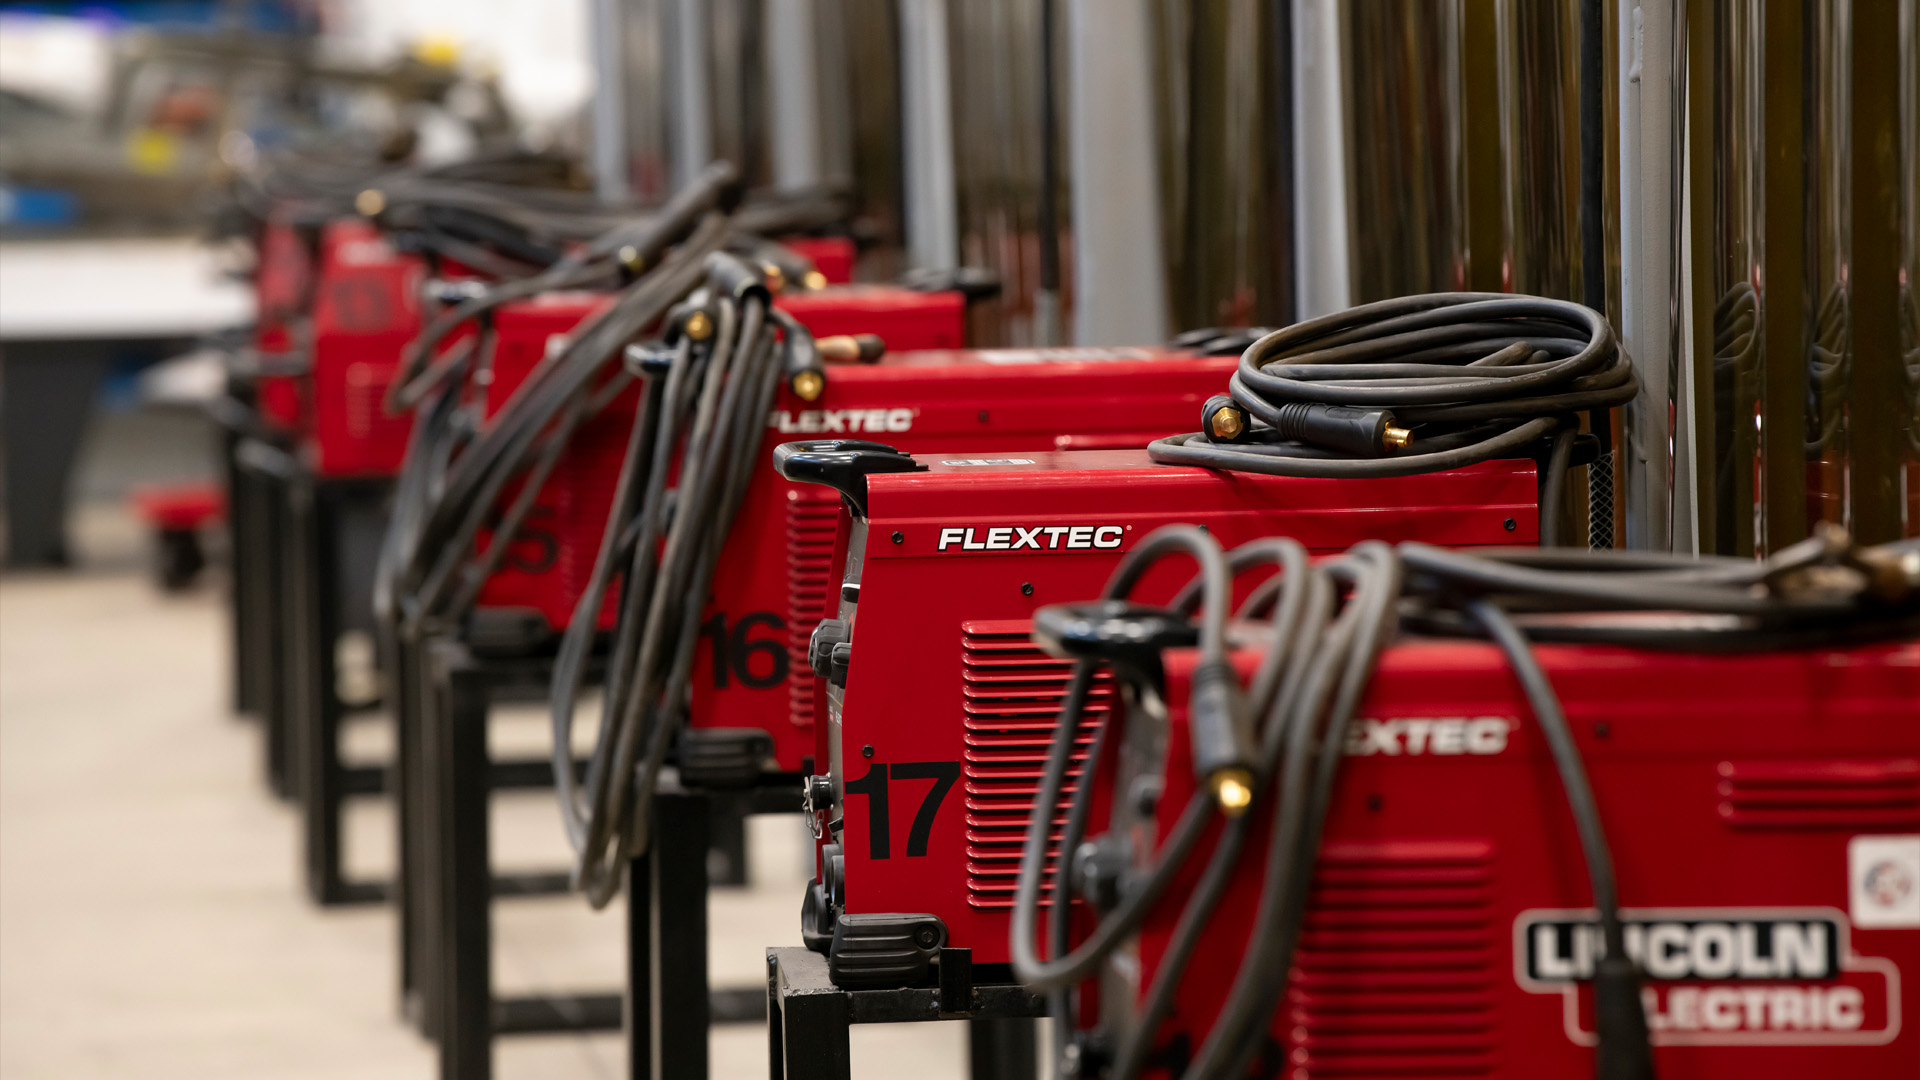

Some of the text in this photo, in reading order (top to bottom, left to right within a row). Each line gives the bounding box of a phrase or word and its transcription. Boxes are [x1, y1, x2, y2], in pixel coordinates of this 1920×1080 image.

[937, 525, 1123, 551] FLEXTEC
[700, 611, 790, 690] 16
[844, 761, 961, 860] 17
[1641, 986, 1865, 1030] LECTRIC
